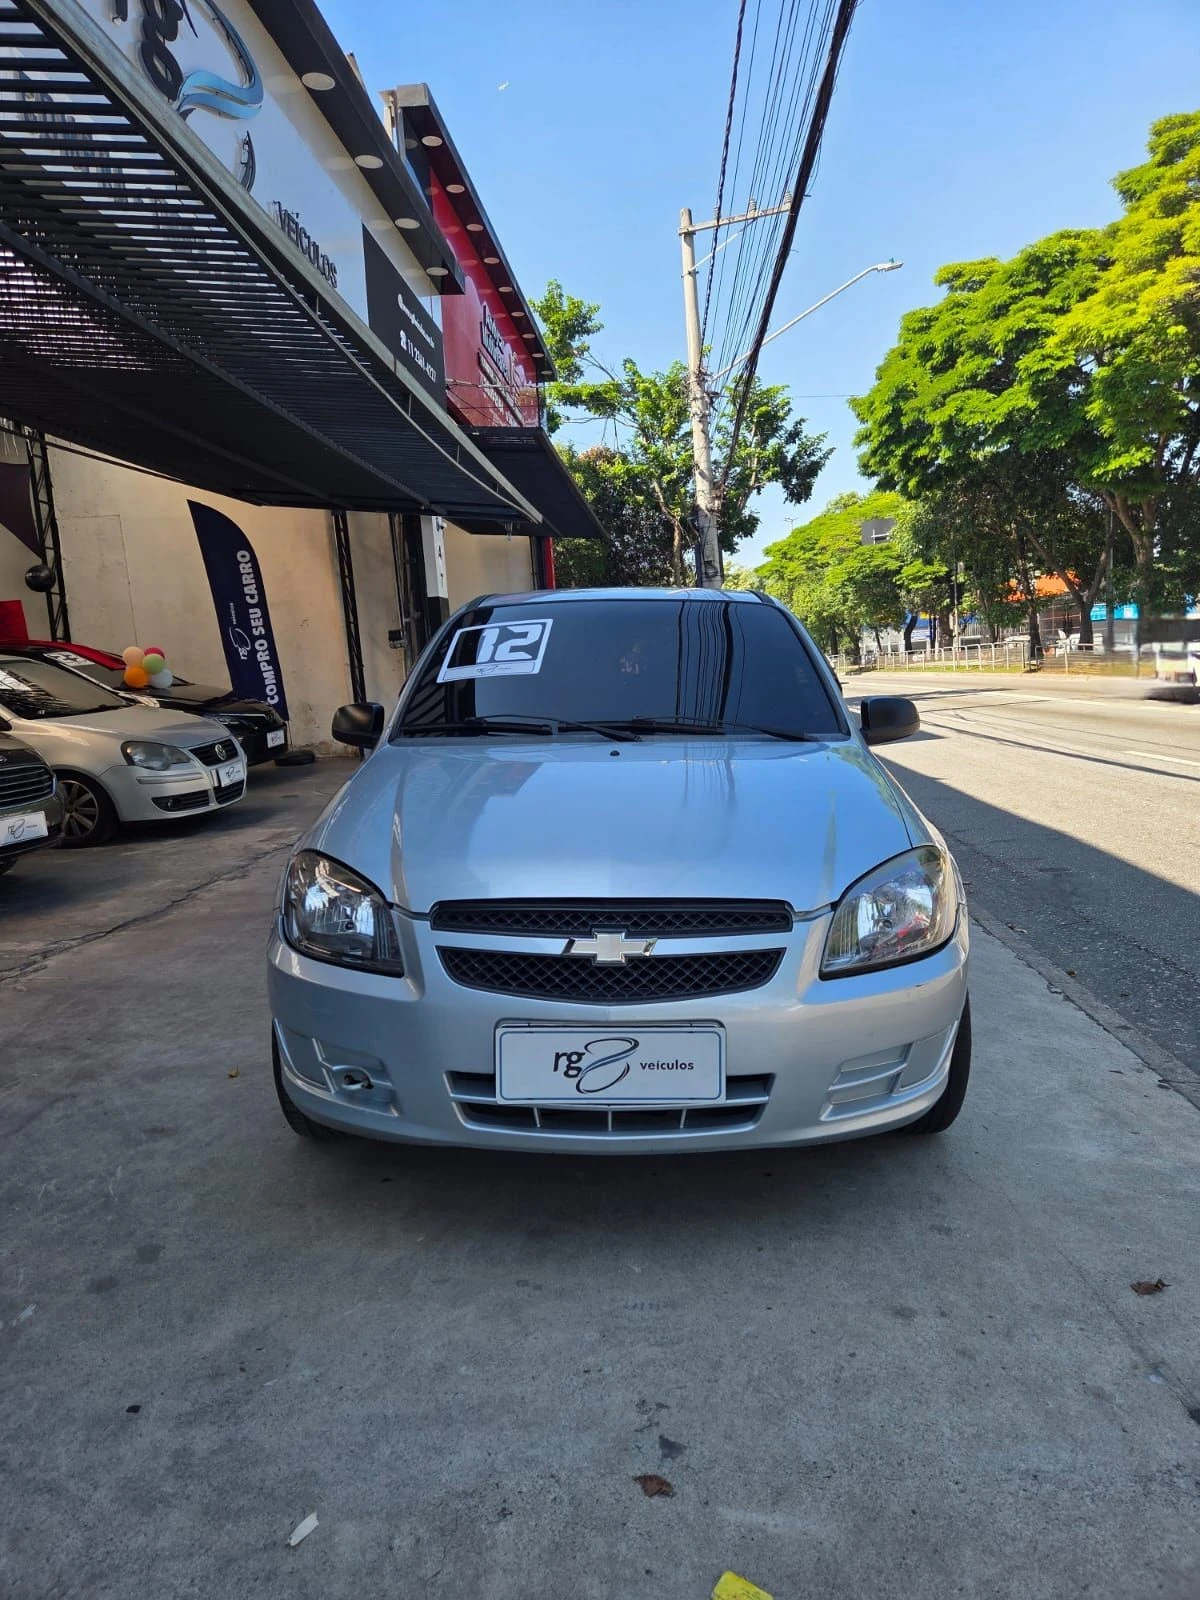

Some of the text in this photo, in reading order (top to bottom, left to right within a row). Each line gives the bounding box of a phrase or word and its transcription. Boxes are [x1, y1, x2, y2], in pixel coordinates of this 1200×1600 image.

[236, 550, 280, 705] COMPRO SEU CARRO
[477, 623, 543, 664] 12
[553, 1051, 586, 1079] rg
